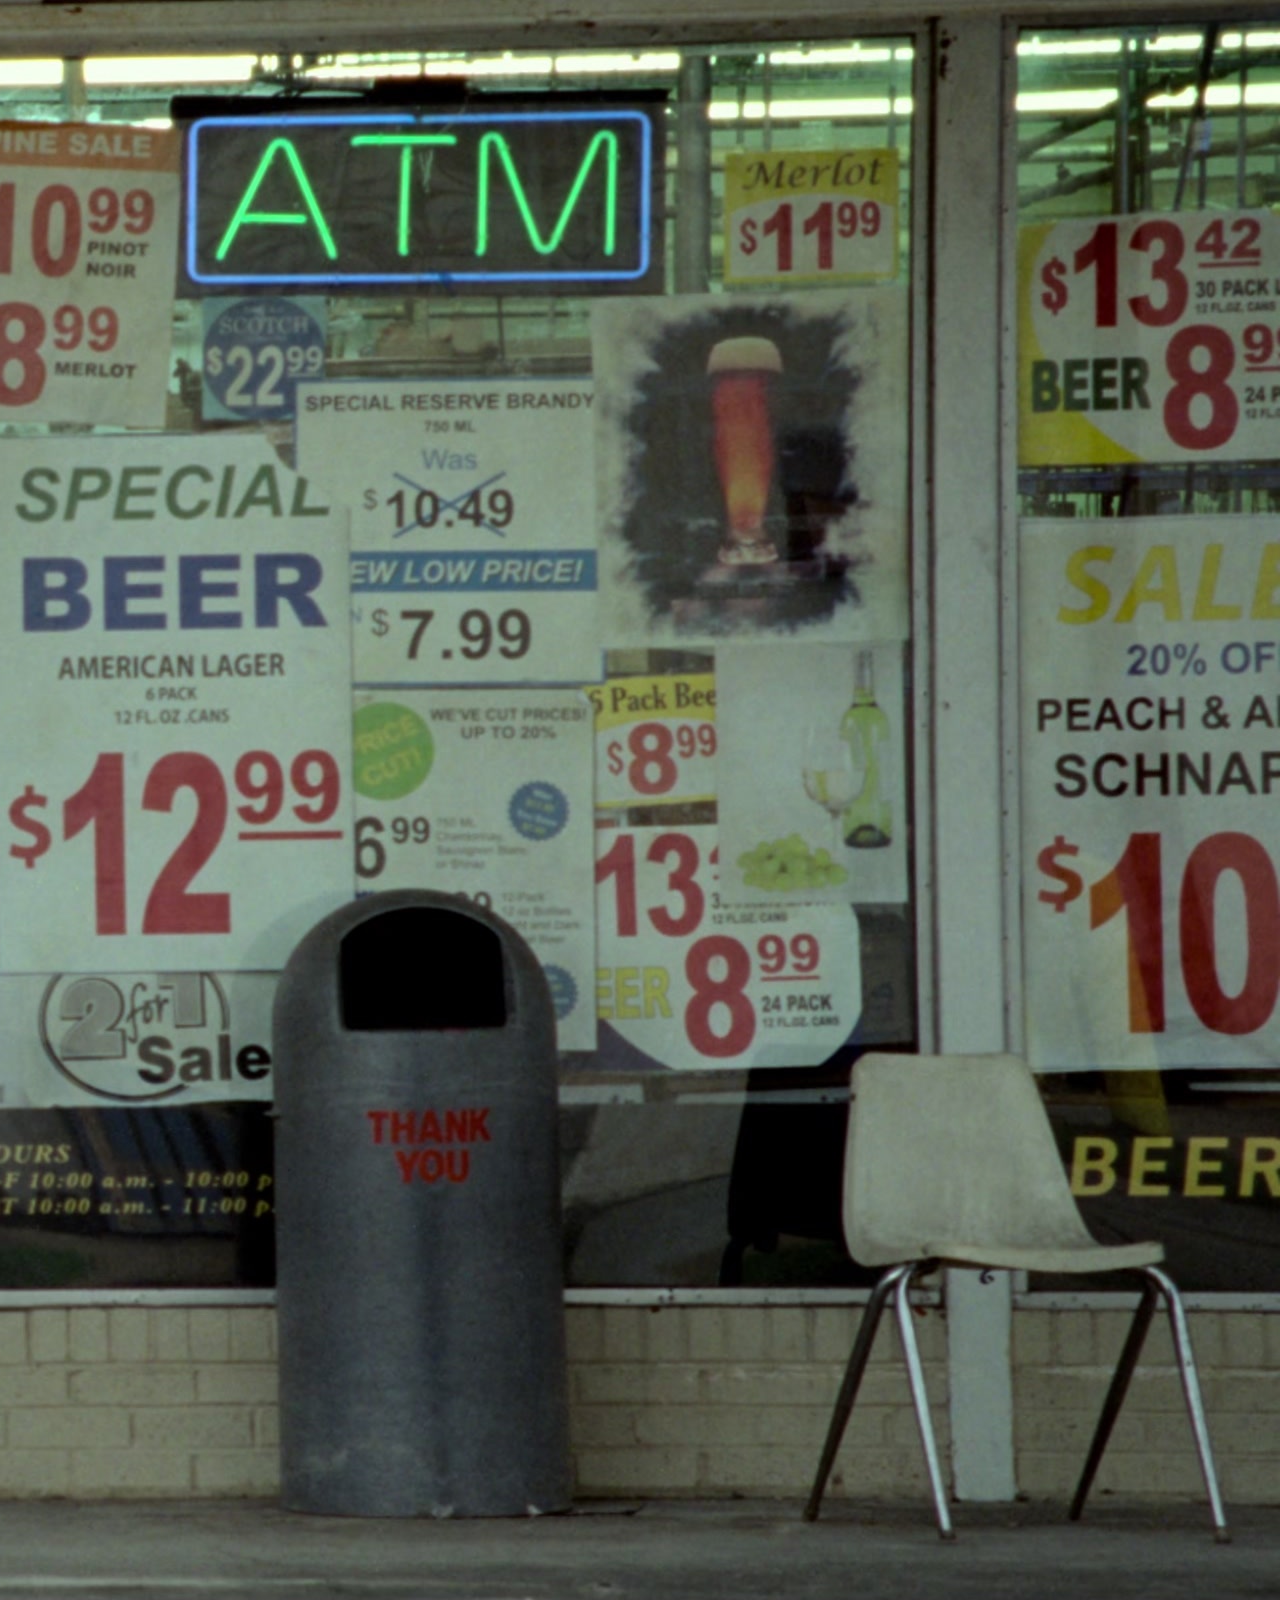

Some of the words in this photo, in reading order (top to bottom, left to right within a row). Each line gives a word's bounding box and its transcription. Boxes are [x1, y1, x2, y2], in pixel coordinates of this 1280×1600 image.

[68, 133, 152, 158] SALE
[742, 153, 886, 192] Merlot
[213, 129, 619, 262] ATM
[87, 241, 149, 256] PINOT
[86, 262, 137, 278] NOIR
[1196, 281, 1216, 299] 30
[1222, 279, 1269, 297] PACK
[218, 315, 308, 334] SCOTCH
[55, 361, 136, 379] MERLOT
[1031, 356, 1151, 414] BEER
[305, 395, 395, 412] SPECIAL
[400, 394, 499, 411] RESERVE
[506, 393, 594, 410] BRANDY
[420, 449, 479, 470] Was
[14, 464, 331, 523] SPECIAL
[351, 561, 398, 583] EW
[403, 560, 476, 584] LOW
[481, 559, 584, 583] PRICE!
[22, 552, 329, 632] BEER
[58, 654, 195, 681] AMERICAN
[202, 653, 286, 678] LAGER
[1126, 642, 1208, 677] 20%
[490, 706, 519, 721] CUT
[1036, 696, 1186, 733] PEACH
[1201, 695, 1232, 730] &
[459, 726, 487, 740] UP
[491, 725, 517, 740] TO
[520, 725, 559, 740] 20%
[58, 976, 128, 1060] 2
[137, 1035, 272, 1084] Sale
[367, 1109, 491, 1146] THANK
[395, 1149, 470, 1185] YOU
[29, 1171, 94, 1189] 10:00
[101, 1174, 157, 1190] a.m.
[185, 1170, 250, 1189] 10:00
[26, 1197, 91, 1216] 10:00
[98, 1201, 154, 1216] a.m.
[181, 1197, 247, 1216] 11:00
